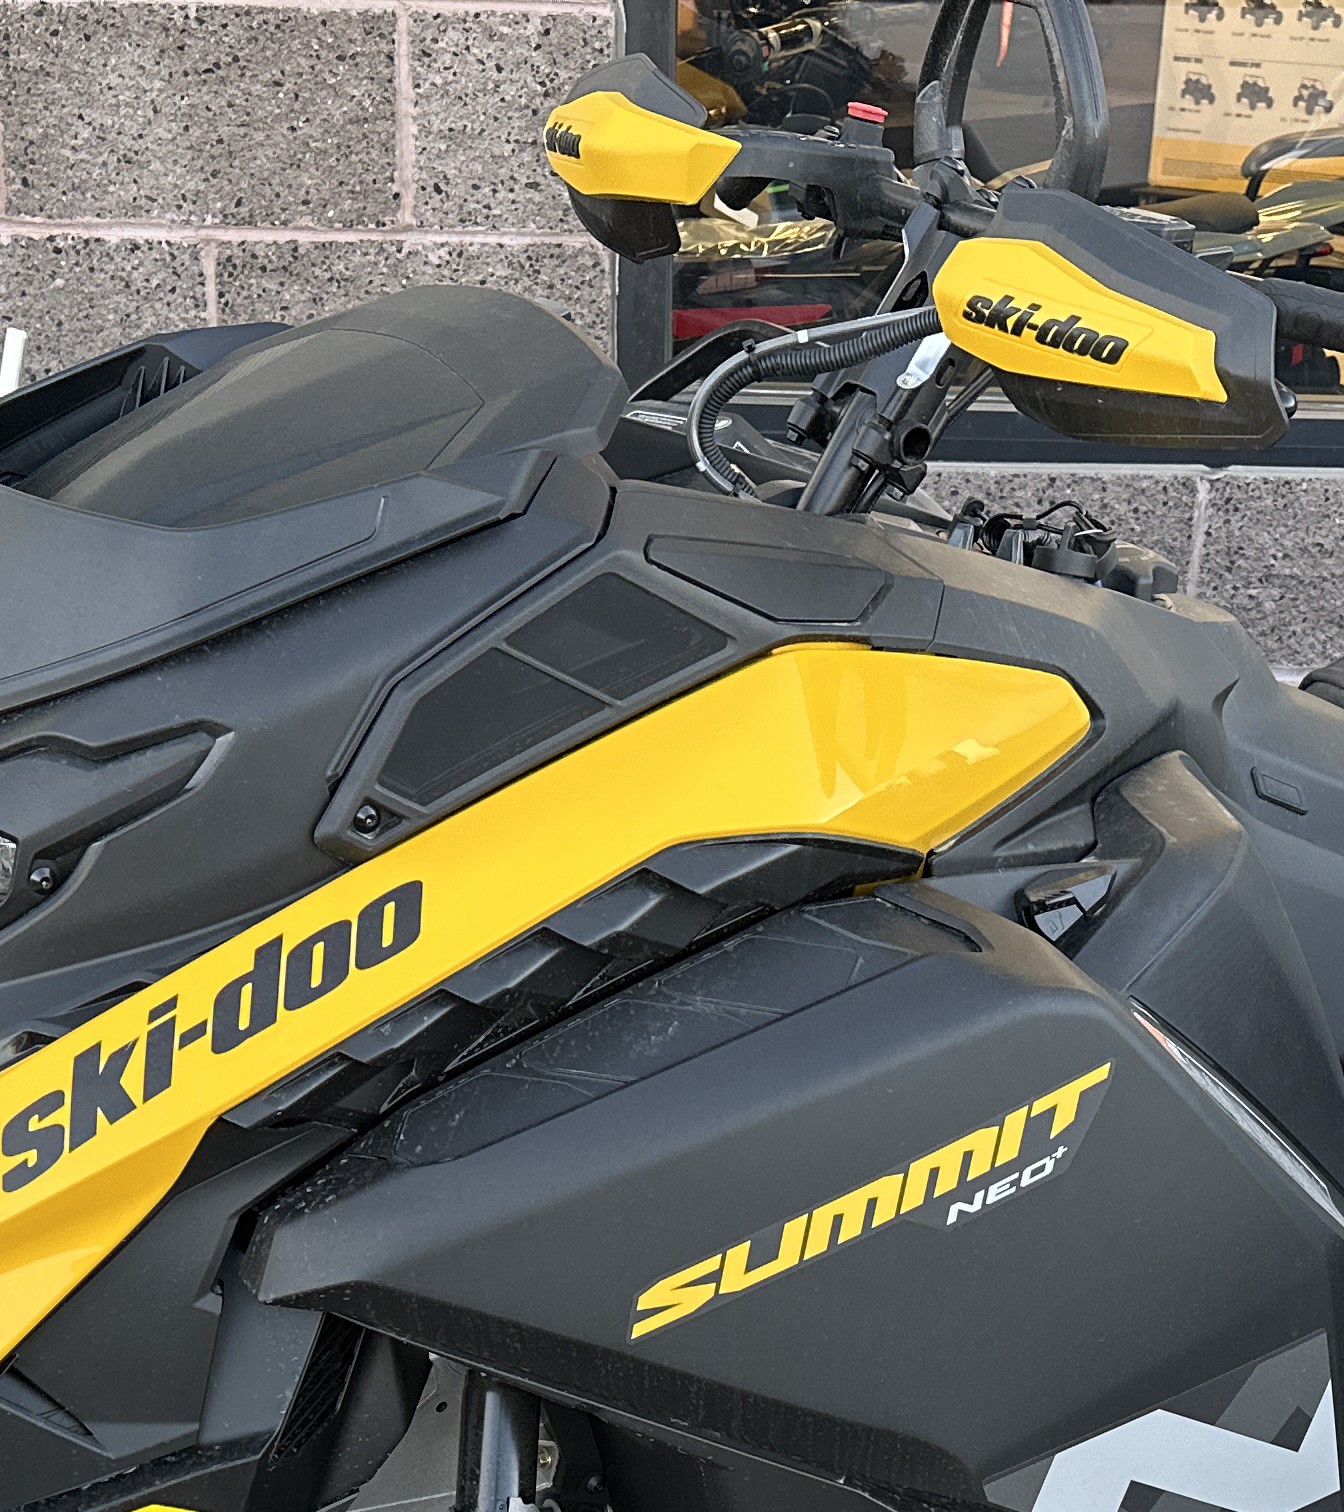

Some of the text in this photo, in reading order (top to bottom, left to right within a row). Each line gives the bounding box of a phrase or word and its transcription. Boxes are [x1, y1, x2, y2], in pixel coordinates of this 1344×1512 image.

[962, 294, 1129, 365] ski-doo
[1, 880, 423, 1193] ski-doo
[630, 1061, 1114, 1341] SUMMIT
